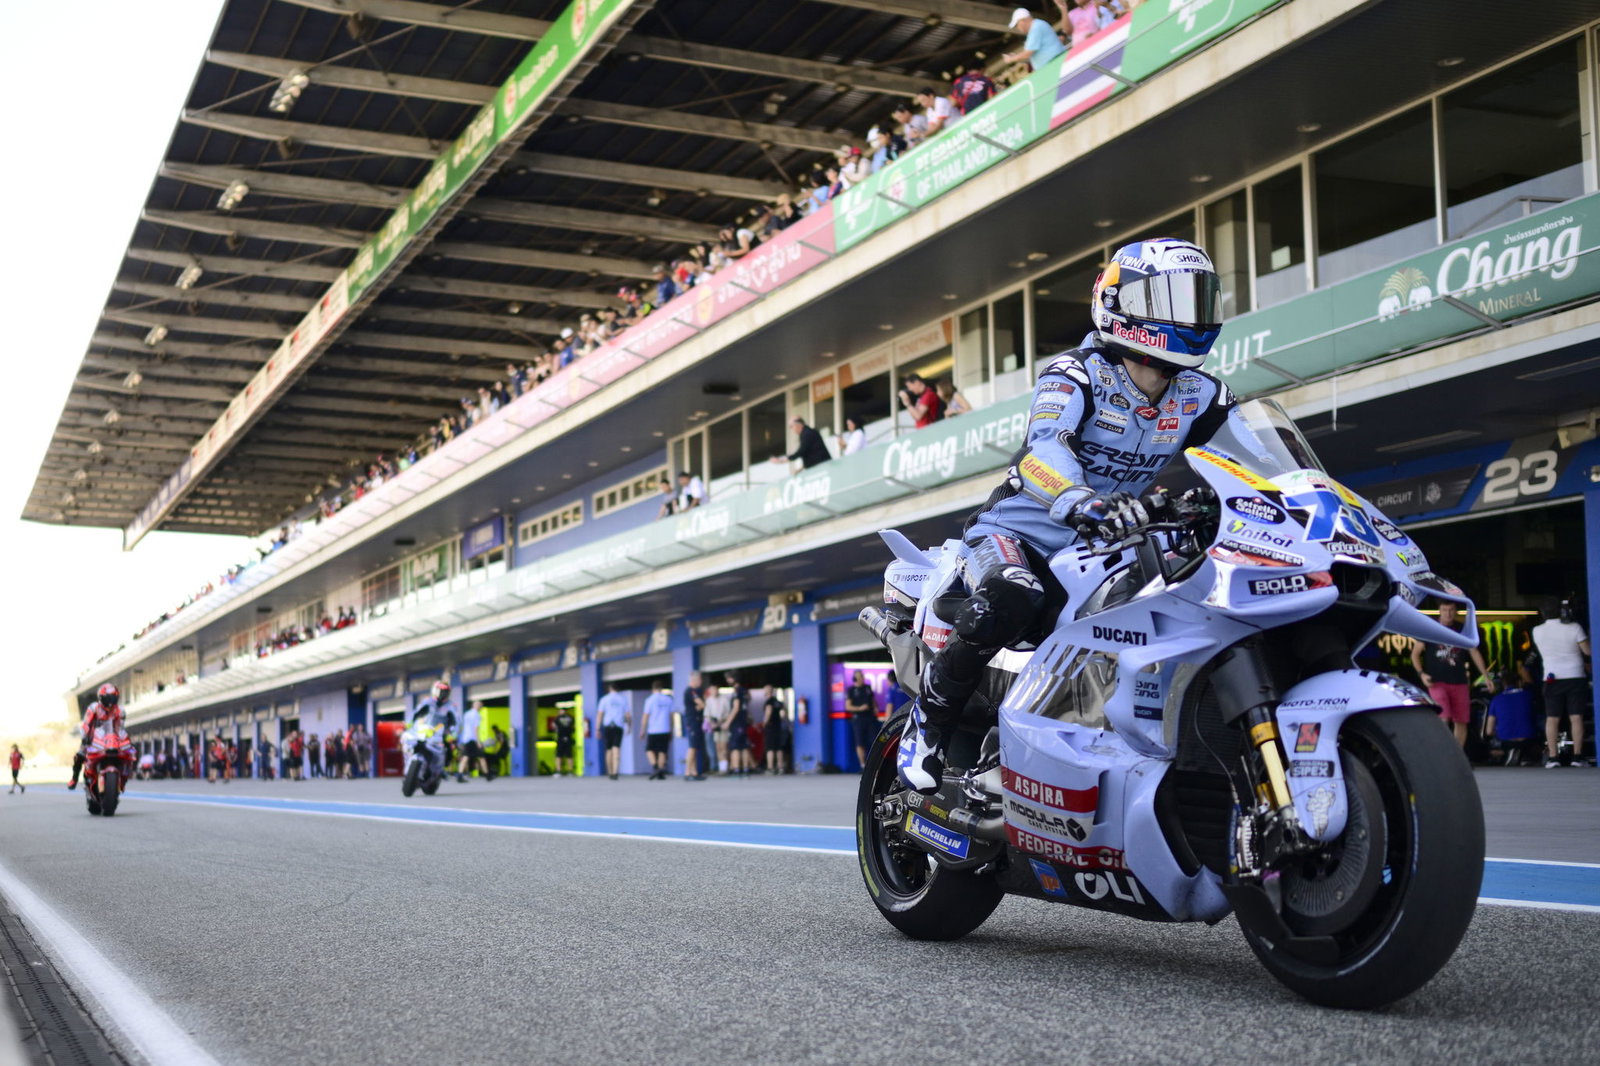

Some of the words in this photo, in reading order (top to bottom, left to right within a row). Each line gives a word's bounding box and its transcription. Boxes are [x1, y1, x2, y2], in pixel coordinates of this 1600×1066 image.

[1436, 224, 1582, 300] Chang
[1479, 287, 1542, 316] MINERAL
[1112, 320, 1136, 341] Red
[1138, 326, 1168, 350] Bull
[882, 434, 958, 479] Chang
[1483, 449, 1558, 504] 23
[1235, 498, 1278, 516] Estrella
[1235, 504, 1275, 522] Galicia
[1377, 491, 1413, 507] CIRCUIT
[1227, 519, 1294, 548] Unibat
[1255, 575, 1305, 592] BOLD
[1092, 625, 1148, 646] DUCATI
[1293, 766, 1329, 778] SIPEX
[1014, 775, 1065, 807] ASPIRA
[1009, 799, 1066, 830] MODULA
[920, 825, 962, 850] MICHELIN
[1017, 830, 1089, 867] FEDERAL
